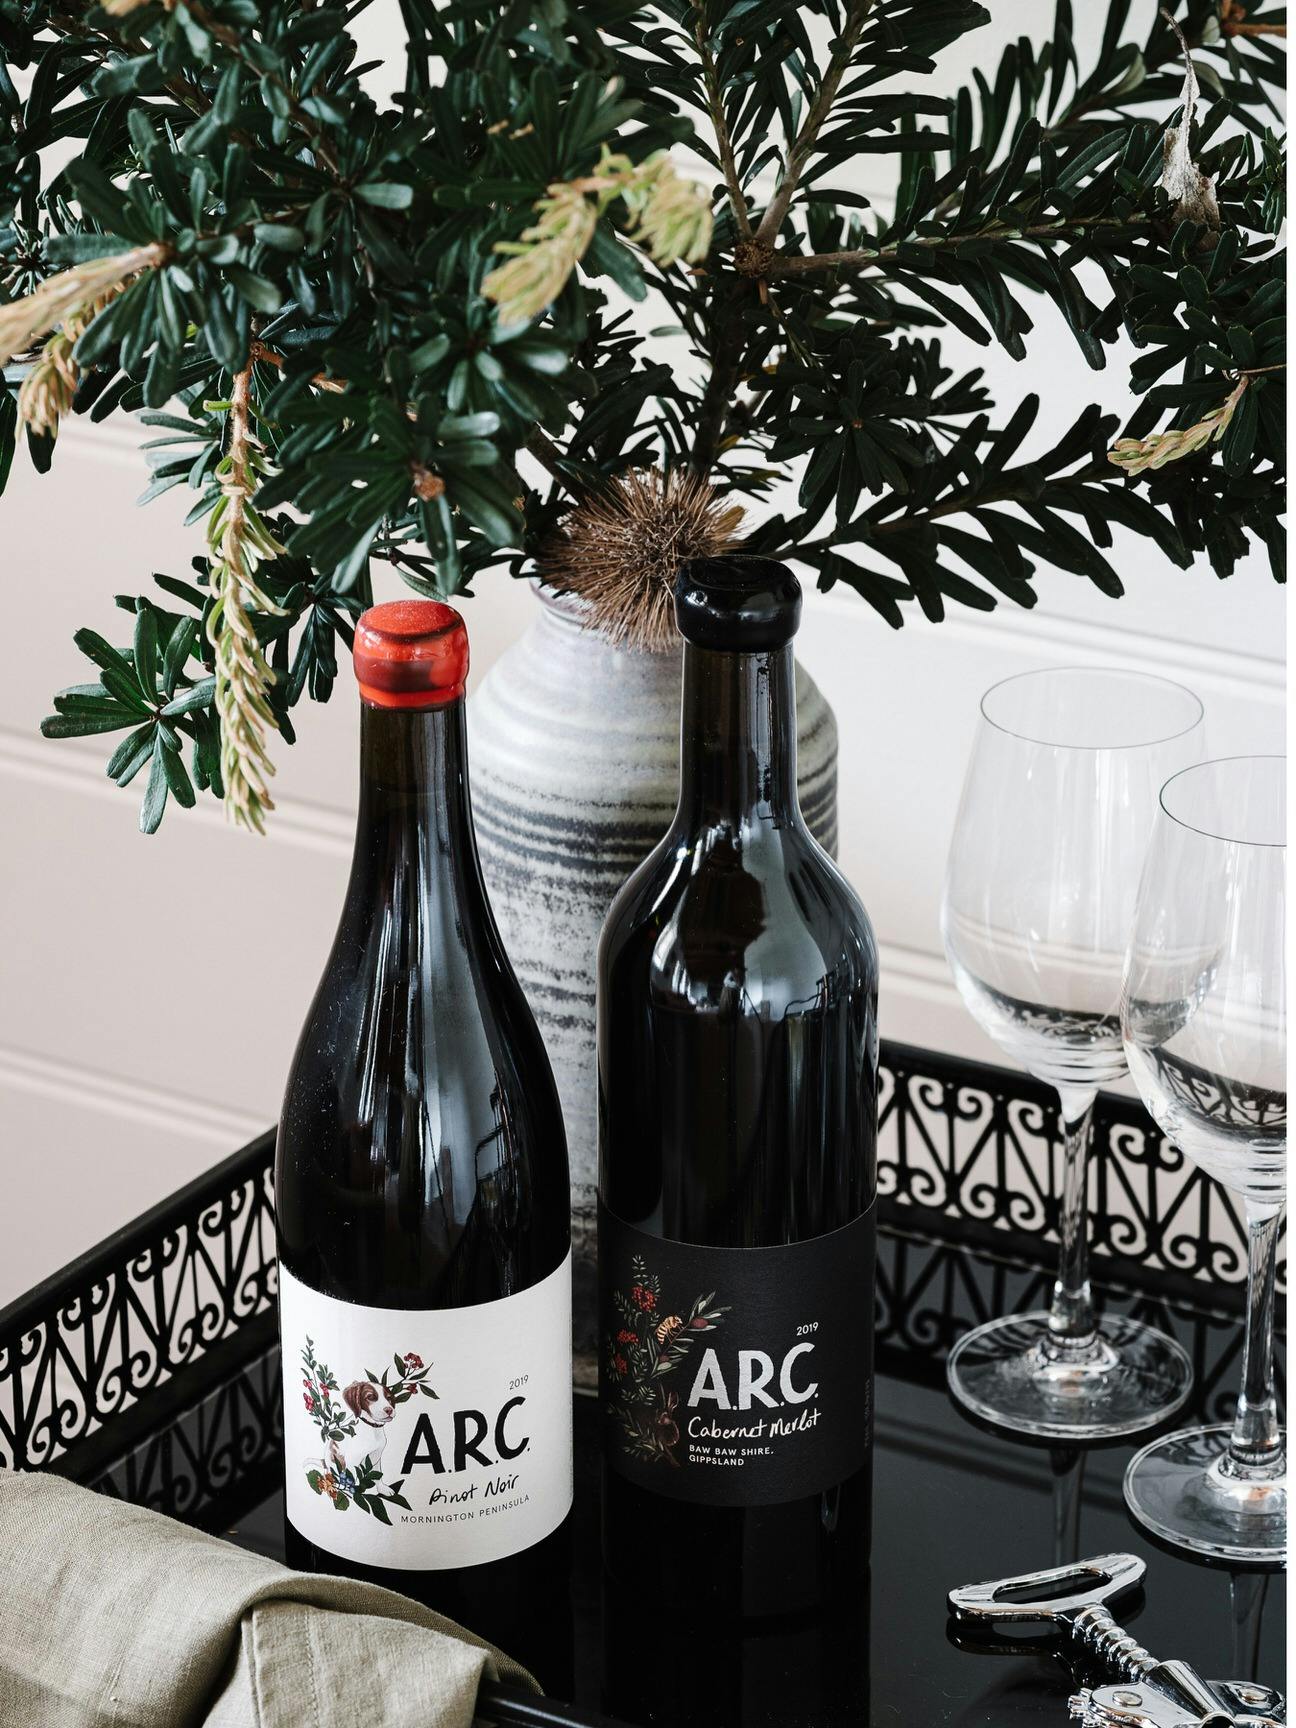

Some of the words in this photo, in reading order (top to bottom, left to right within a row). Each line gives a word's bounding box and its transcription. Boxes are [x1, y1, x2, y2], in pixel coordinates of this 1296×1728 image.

[796, 1321, 819, 1336] 2019
[509, 1374, 529, 1391] 2019
[687, 1416, 768, 1439] Cabernet
[769, 1407, 822, 1438] Merlot
[689, 1444, 711, 1454] BAW
[714, 1447, 737, 1456] BAW
[688, 1454, 745, 1466] GIPPSLAND
[428, 1483, 479, 1506] Pinot
[484, 1473, 520, 1498] Noir
[400, 1511, 475, 1524] MORNINGTON
[479, 1494, 531, 1517] PENINSULA
